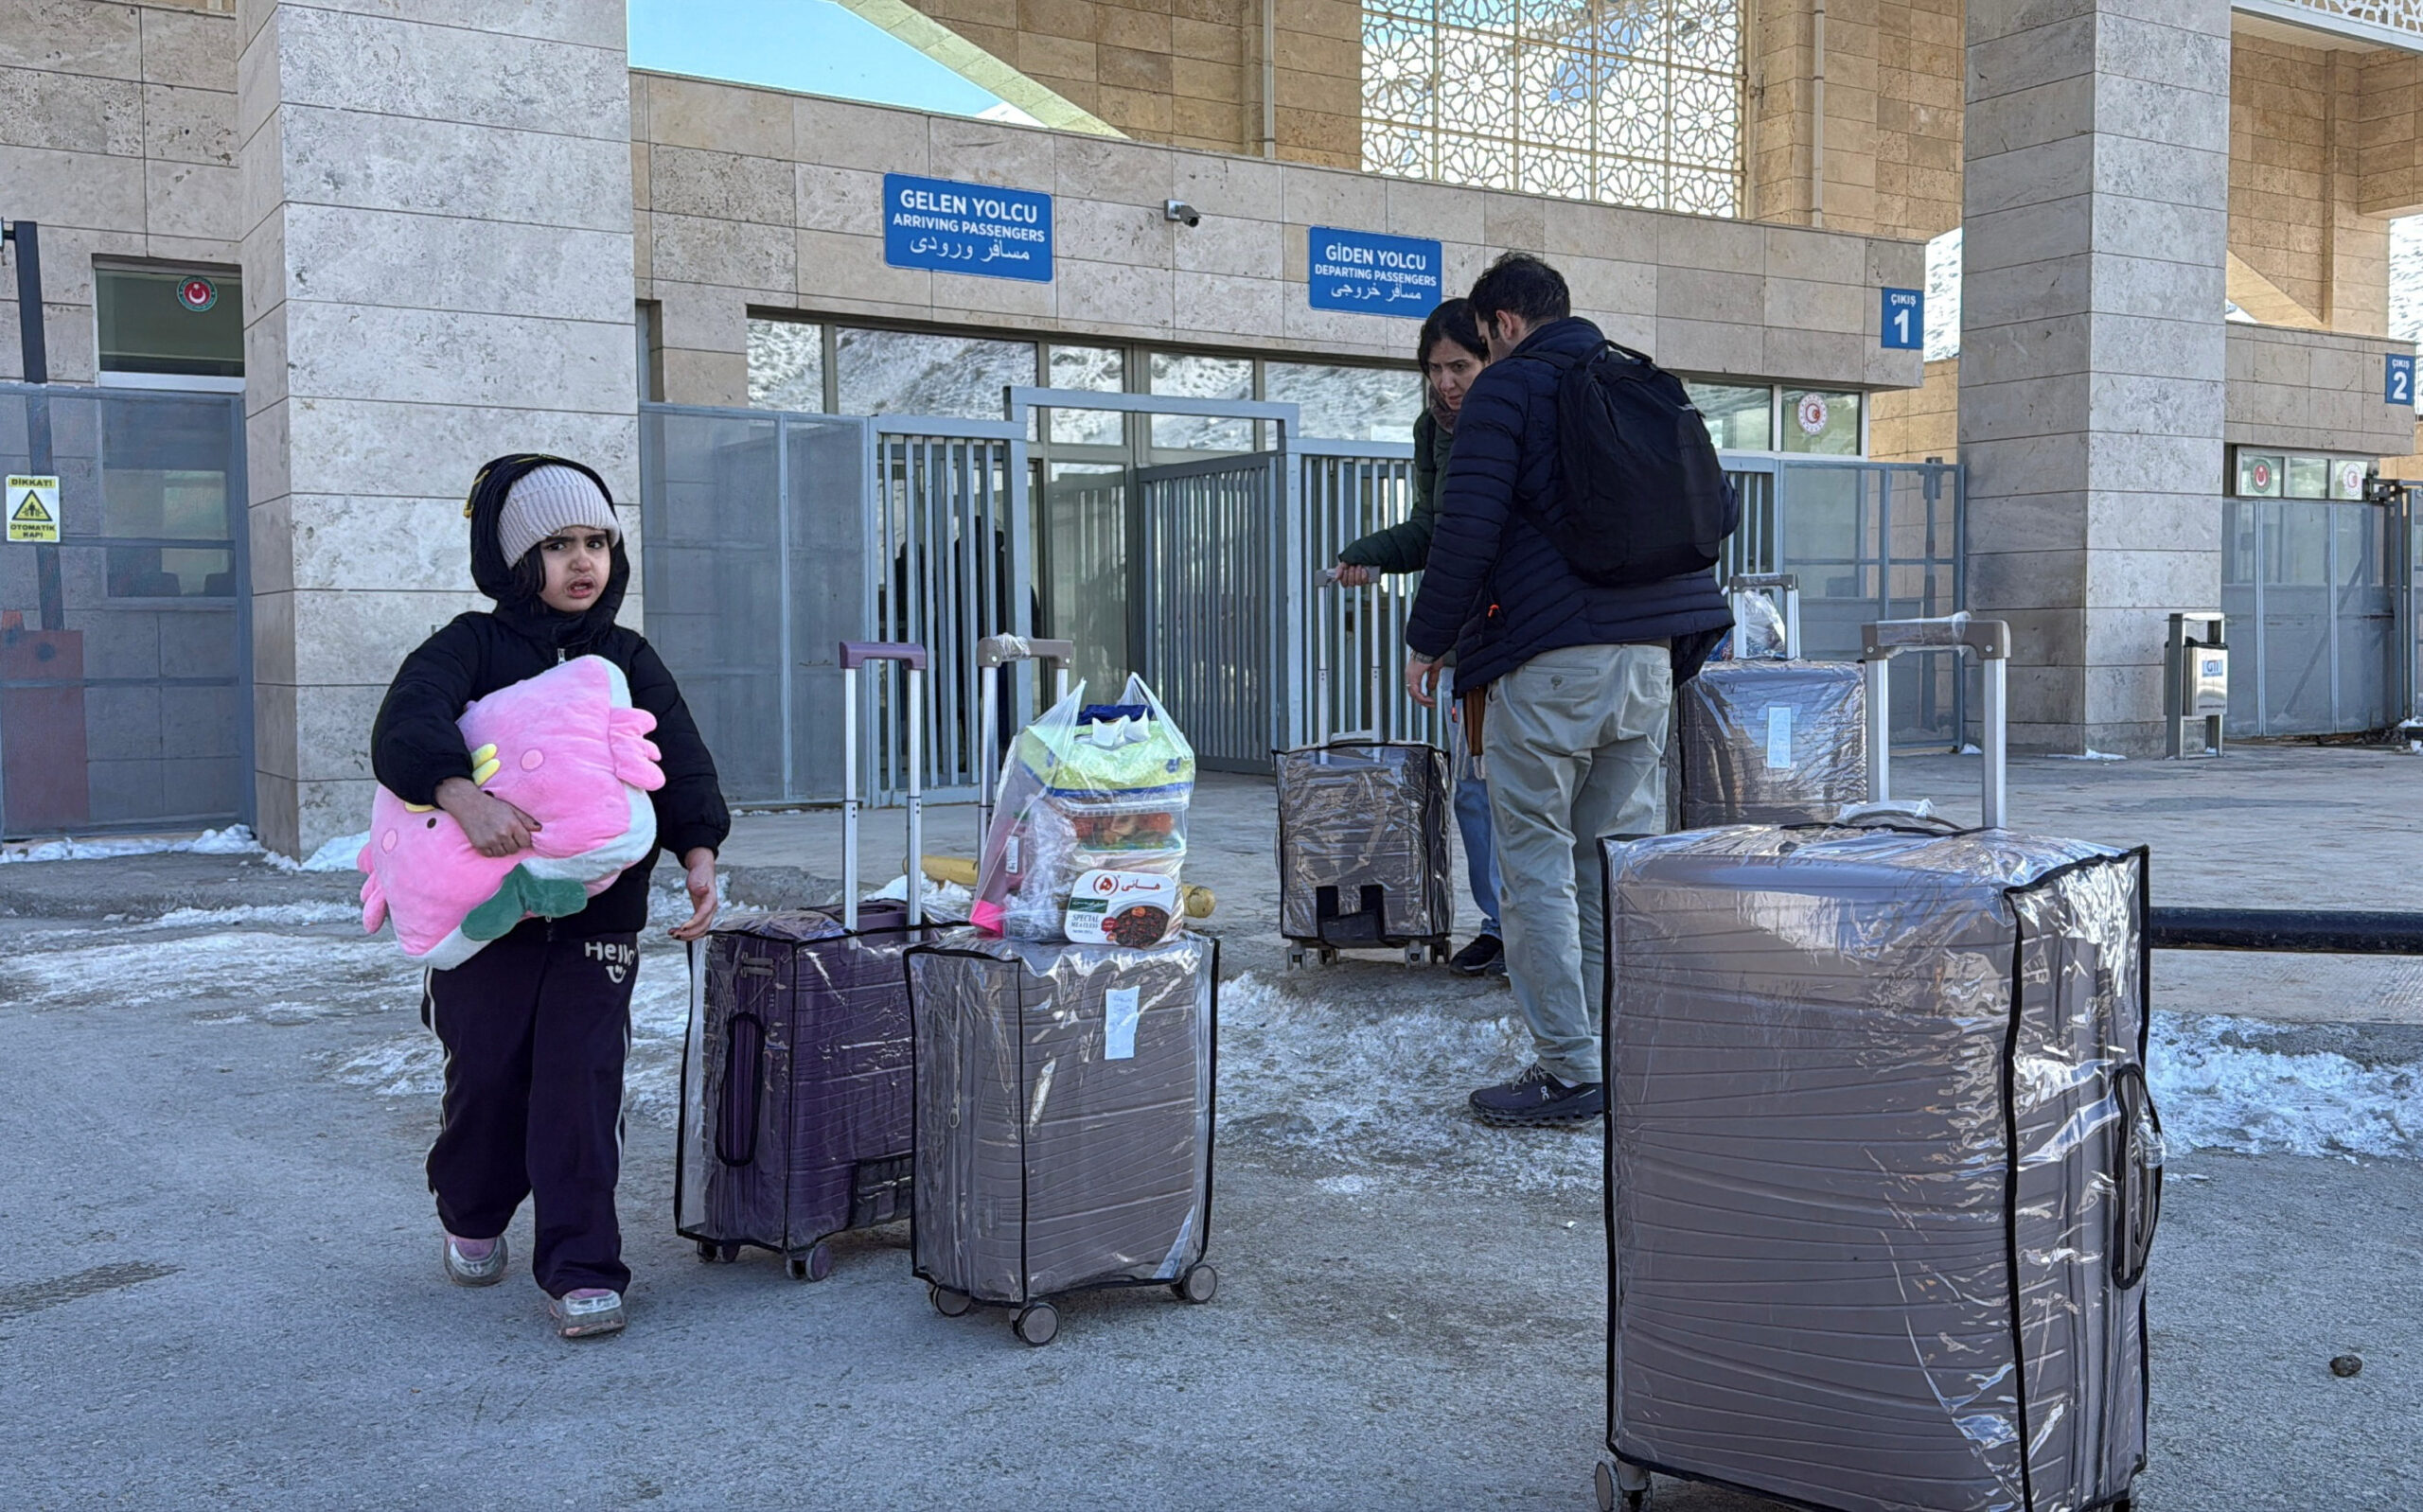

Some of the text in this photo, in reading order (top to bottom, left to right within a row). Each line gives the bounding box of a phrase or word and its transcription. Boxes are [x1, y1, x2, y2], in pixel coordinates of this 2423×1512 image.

[900, 189, 1037, 223] GELEN YOLCU
[893, 213, 1046, 243] ARRIVING PASSENGERS
[910, 237, 1030, 262] مسافر ورودی
[1325, 242, 1426, 271] GİDEN YOLCU
[1315, 263, 1437, 287] DEPARTING PASSENGERS
[1331, 283, 1422, 302] مسافر خروجی
[1890, 293, 1917, 308] ÇIKIŞ
[1894, 308, 1909, 343] 1
[2393, 371, 2408, 400] 2
[9, 523, 56, 532] OTOMATİK
[1072, 914, 1099, 923] SPECIAL
[584, 941, 635, 966] Hello
